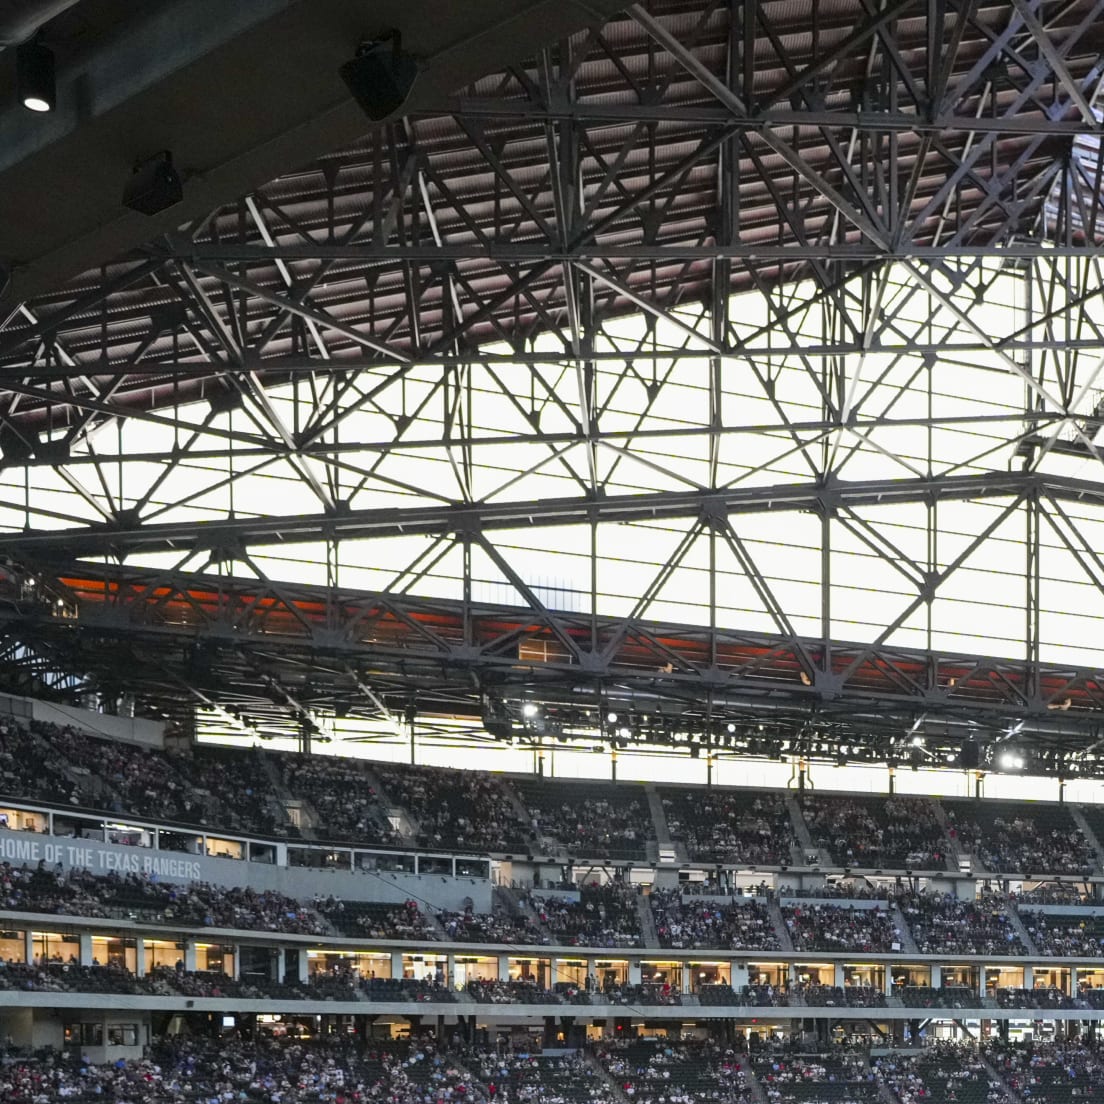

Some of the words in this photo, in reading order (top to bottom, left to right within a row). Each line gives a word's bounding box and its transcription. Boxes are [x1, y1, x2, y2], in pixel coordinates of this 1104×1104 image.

[0, 838, 40, 860] HOME
[44, 844, 63, 863] OF
[67, 846, 94, 868] THE
[98, 850, 139, 873] TEXAS
[143, 857, 201, 880] RANGERS
